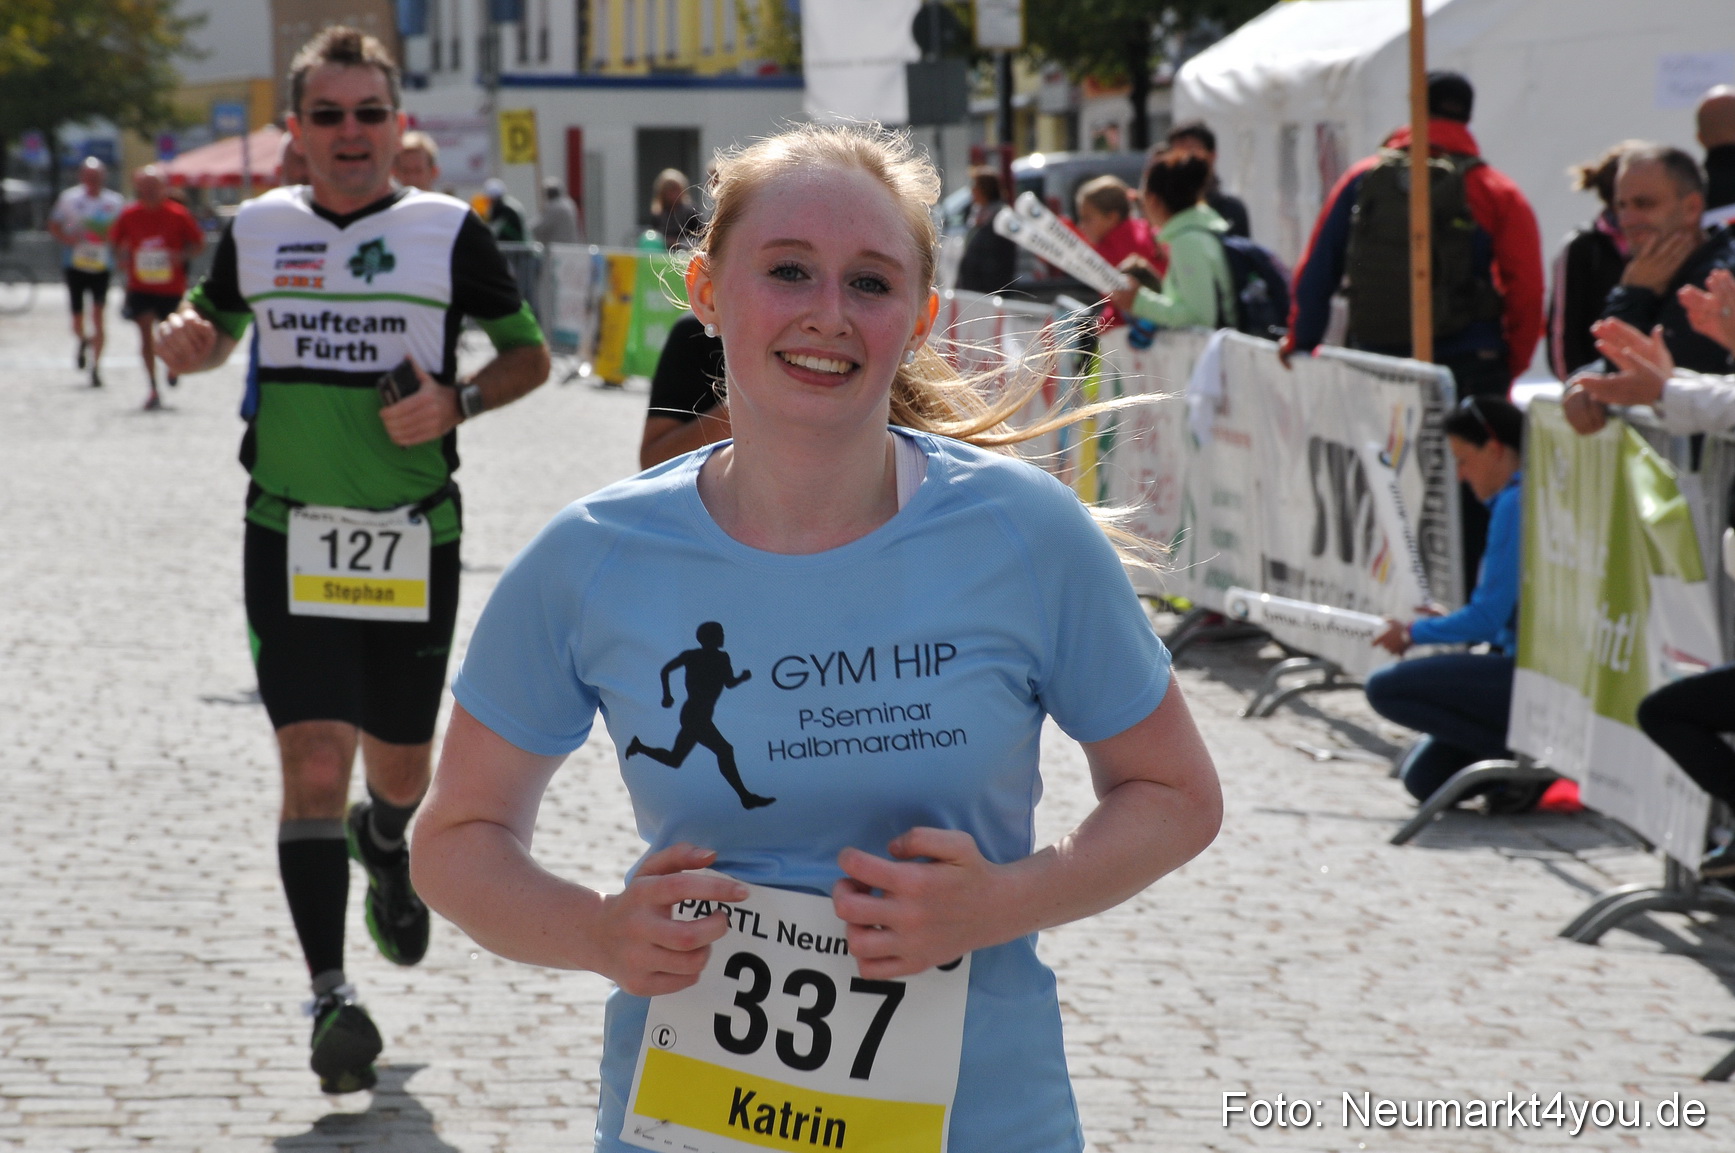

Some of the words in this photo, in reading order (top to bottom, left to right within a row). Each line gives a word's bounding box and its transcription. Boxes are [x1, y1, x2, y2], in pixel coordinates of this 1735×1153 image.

[268, 308, 407, 333] Laufteam
[296, 336, 378, 361] Fürth
[320, 528, 402, 571] 127
[323, 581, 395, 603] Stephan
[771, 646, 876, 691] GYM
[893, 642, 958, 679] HIP
[799, 702, 932, 730] P-Seminar
[767, 728, 967, 761] Halbmarathon
[714, 951, 906, 1080] 337
[728, 1086, 846, 1149] Katrin
